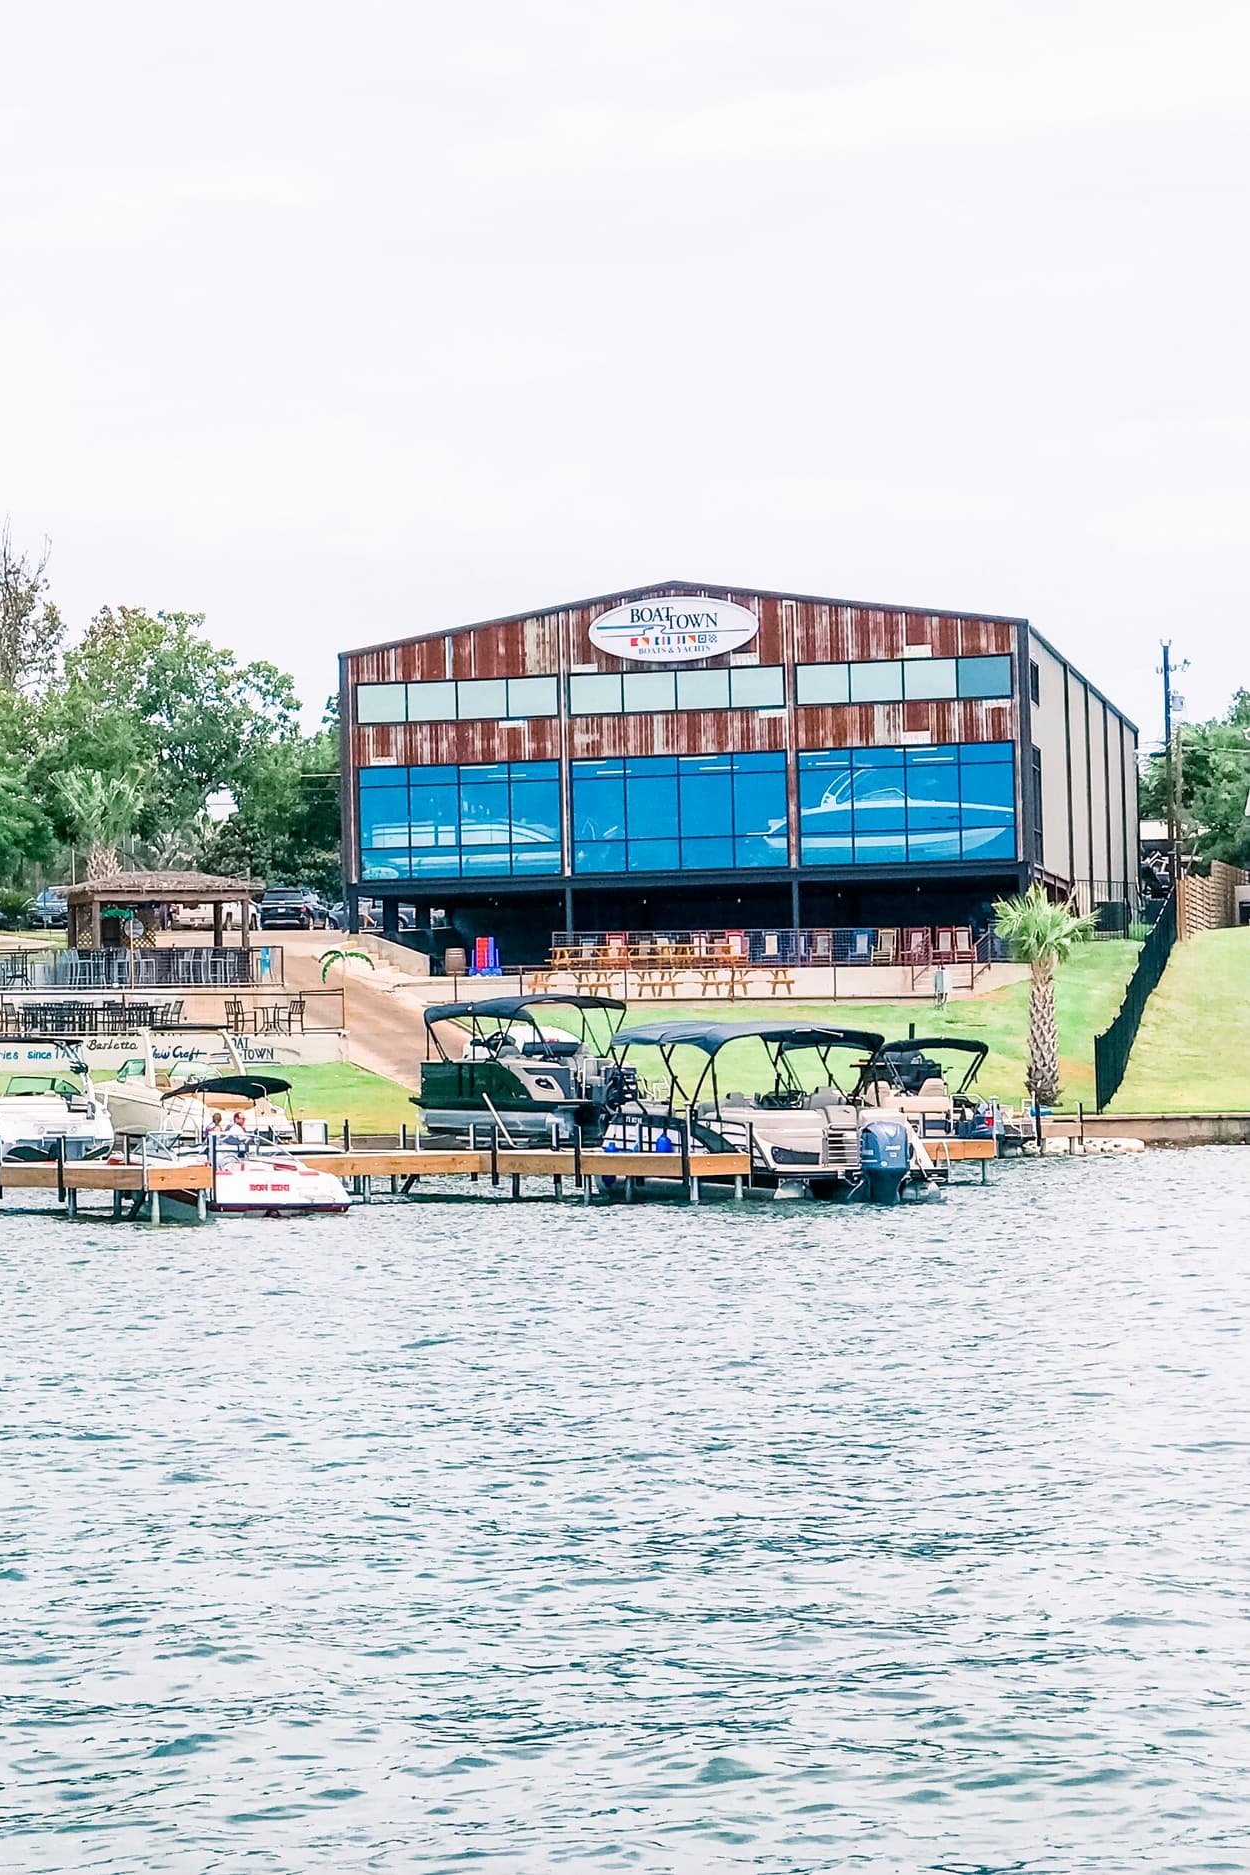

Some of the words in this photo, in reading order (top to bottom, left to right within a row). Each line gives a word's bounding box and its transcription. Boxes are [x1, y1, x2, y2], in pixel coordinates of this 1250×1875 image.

[630, 607, 673, 623] BOAT
[669, 612, 718, 629] TOWN
[639, 647, 666, 655] BOATS
[668, 646, 674, 654] &
[677, 645, 711, 653] YACHTS
[27, 1049, 52, 1061] since
[242, 1048, 274, 1060] TOWN
